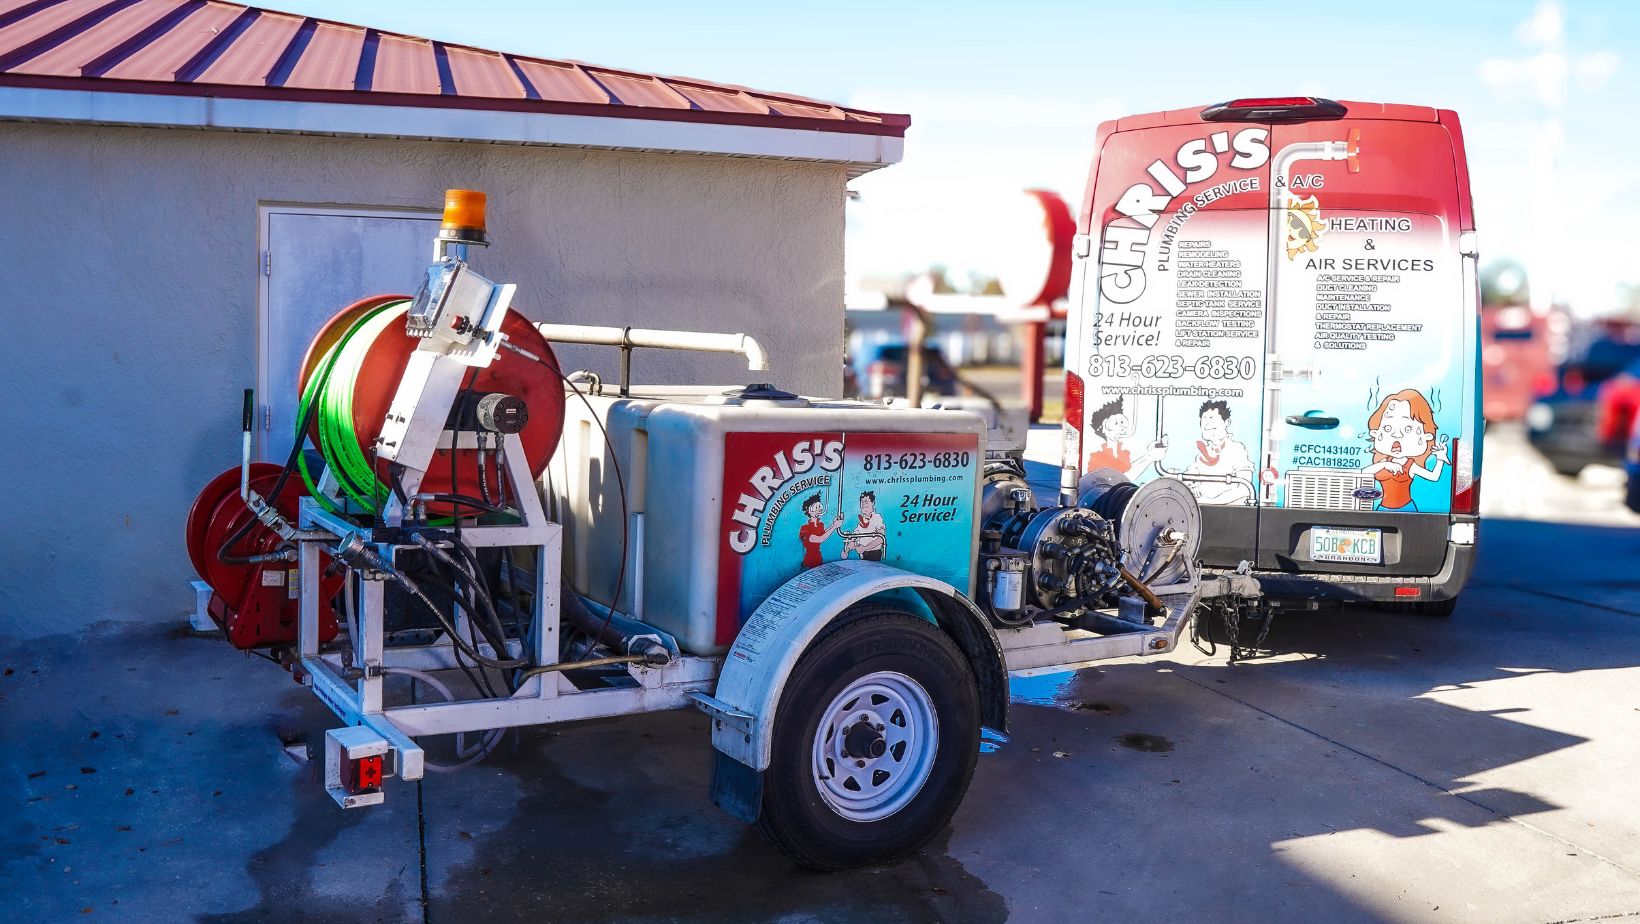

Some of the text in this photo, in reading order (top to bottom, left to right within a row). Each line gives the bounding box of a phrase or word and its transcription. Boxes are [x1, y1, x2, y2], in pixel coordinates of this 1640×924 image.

[1101, 128, 1270, 304] CHRIS'S
[1158, 175, 1323, 271] PLUMBING SERVICE & A/C
[1330, 219, 1411, 231] HEATING
[1178, 241, 1211, 249] REPAIRS
[1364, 239, 1375, 250] &
[1177, 260, 1241, 268] WATER HEATERS
[1306, 258, 1434, 271] AIR SERVICES
[1177, 270, 1241, 278] DRAIN CLEANING
[1177, 280, 1242, 288] LEAK DETECTION
[1176, 290, 1261, 298] SEWER INSTALLATION
[1316, 294, 1371, 302] MAINTENANCE
[1176, 300, 1261, 308] SEPTIC TANK SERVICE
[1316, 303, 1391, 311] DUCT INSTALLATION
[1176, 310, 1262, 318] CAMERA INSPECTIONS
[1315, 313, 1351, 321] & REPAIR
[1093, 312, 1162, 327] 24 Hour
[1175, 320, 1255, 328] BACKFLOW TESTING
[1315, 322, 1423, 332] THERMOSTAT REPLACEMENT
[1093, 331, 1160, 346] Service!
[1175, 330, 1258, 338] LIFT STATION SERVICE
[1315, 332, 1395, 341] AIR QUALITY TESTING
[1314, 342, 1367, 350] & SOLUTIONS
[1088, 354, 1256, 380] 813-623-6830
[1102, 385, 1243, 397] www.chrissplumbing.com
[1294, 444, 1361, 455] #CFC1431407
[864, 452, 969, 471] 813-623-6830
[1293, 457, 1361, 467] #CAC1818250
[865, 475, 963, 485] www.chrissplumbing.com
[729, 439, 845, 555] CHRIS'S
[901, 494, 958, 508] 24 Hour
[762, 475, 830, 545] PLUMBING SERVICE
[900, 509, 956, 523] Service!
[1353, 538, 1376, 554] KCB
[1324, 554, 1366, 562] BRANDON
